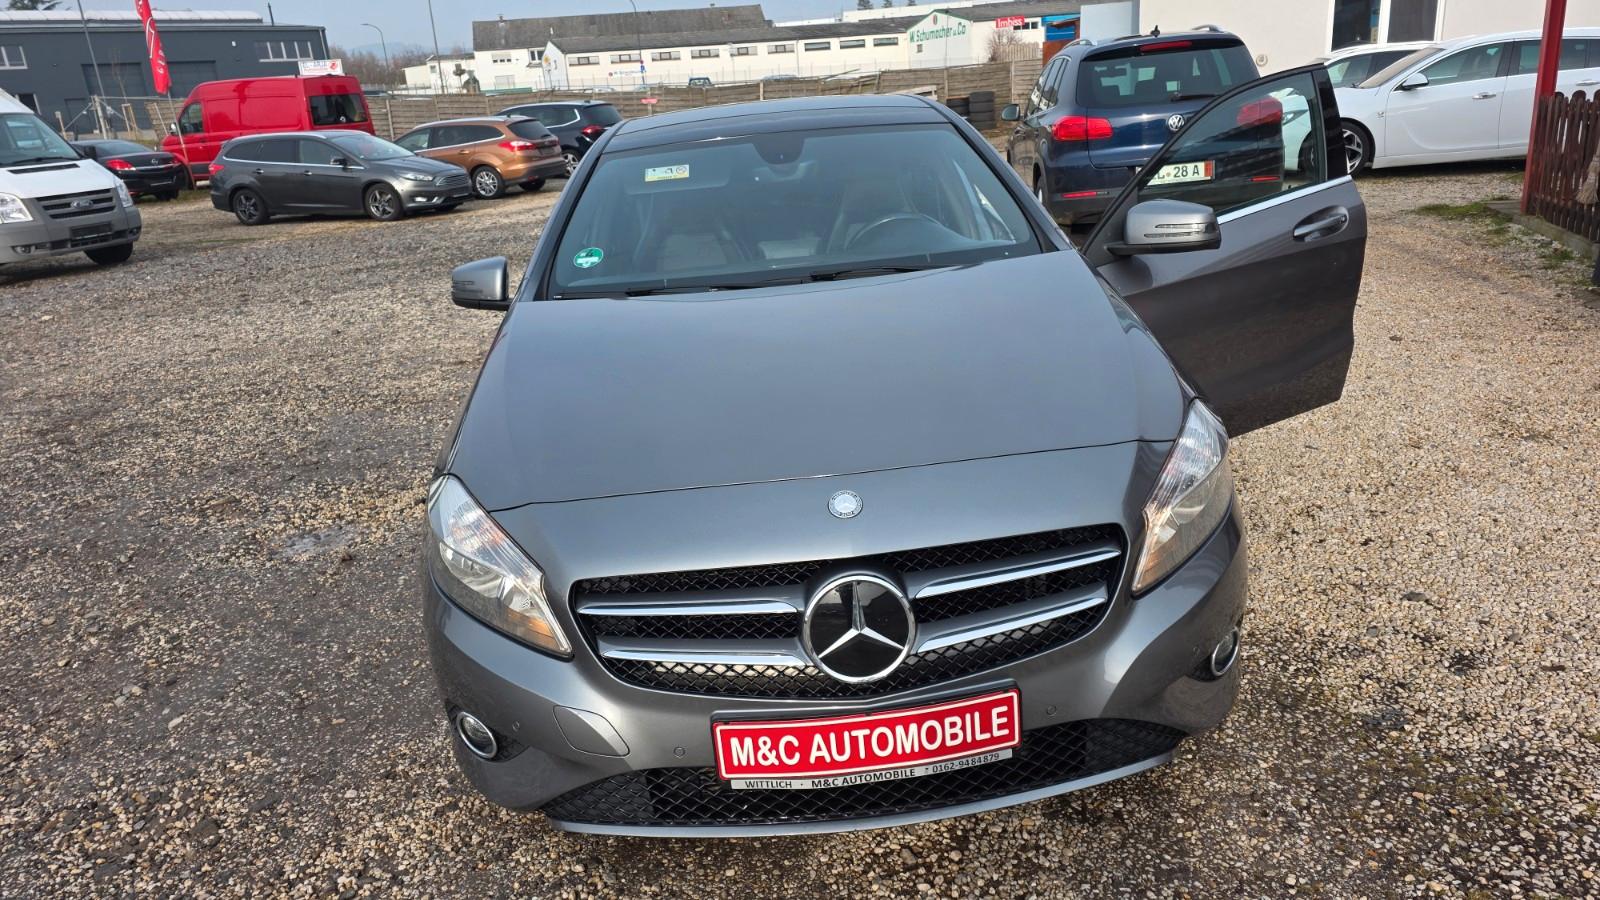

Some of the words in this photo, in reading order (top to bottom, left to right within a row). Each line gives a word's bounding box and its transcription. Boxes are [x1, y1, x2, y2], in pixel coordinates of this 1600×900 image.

[997, 17, 1023, 28] Imbiss
[916, 26, 953, 42] Schumacher
[1173, 166, 1188, 178] 28
[1192, 165, 1200, 176] A
[729, 735, 801, 768] M&C
[809, 705, 1010, 764] AUTOMOBILE
[744, 779, 792, 789] WITTLICH
[811, 777, 839, 788] M&C
[841, 768, 916, 786] AUTOMOBILE
[932, 752, 1000, 774] 0162-9484879
